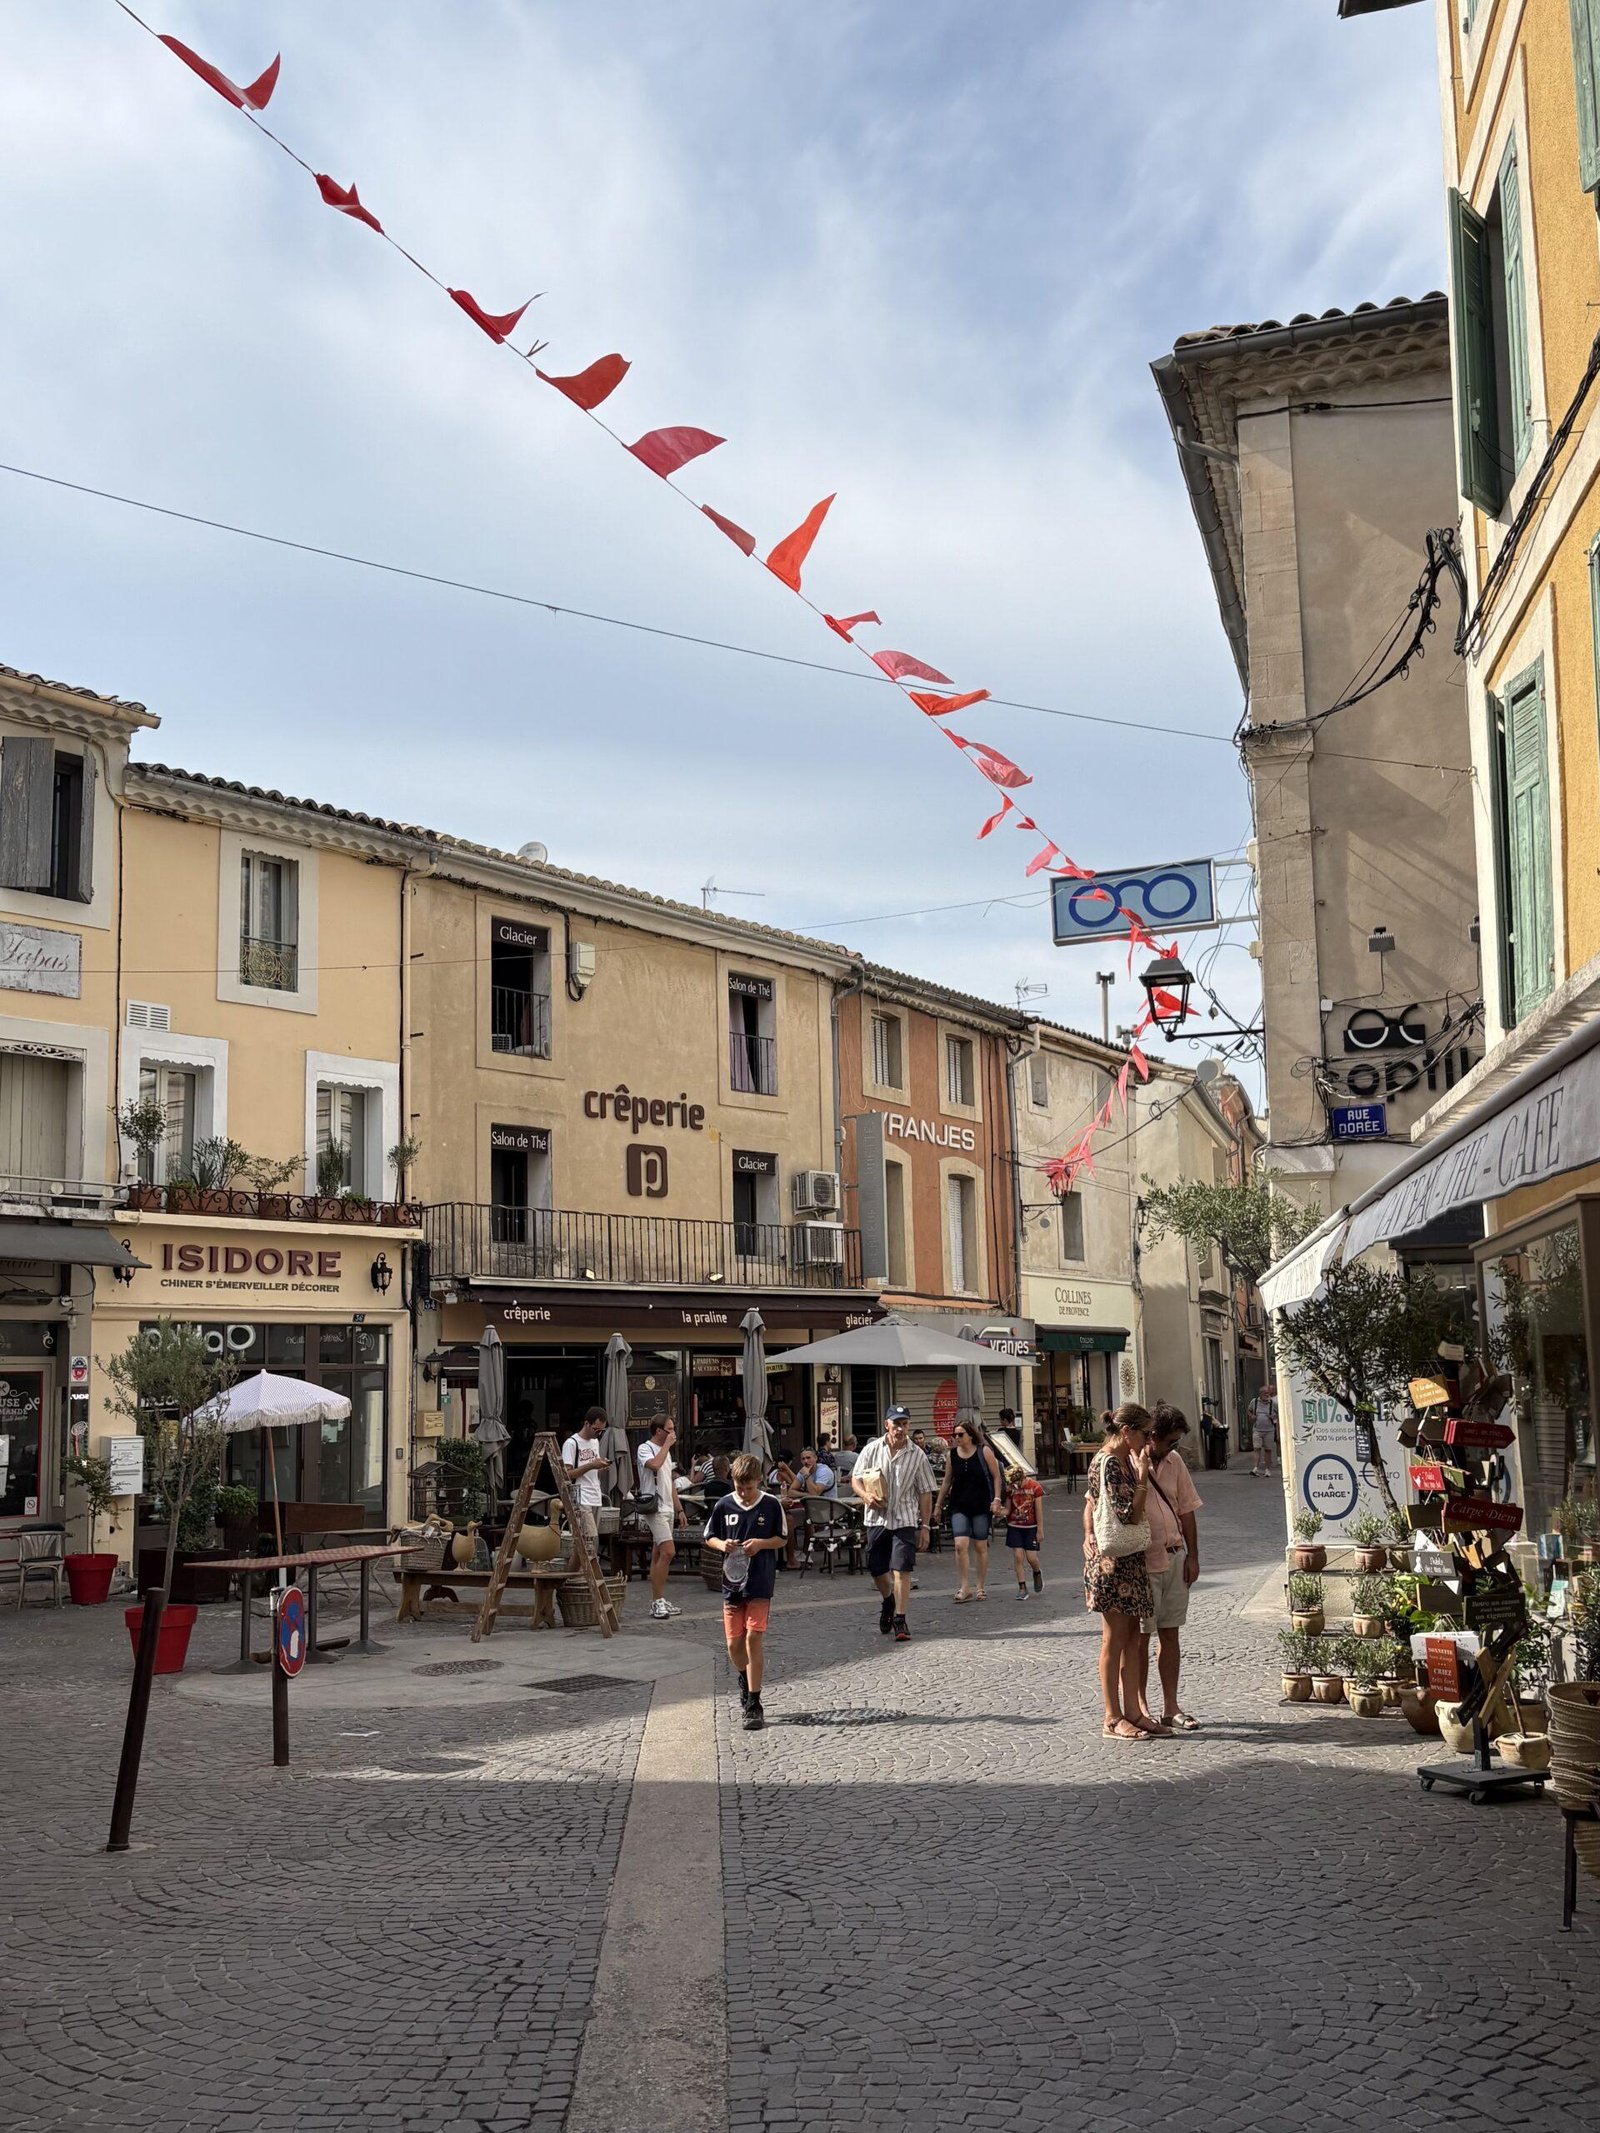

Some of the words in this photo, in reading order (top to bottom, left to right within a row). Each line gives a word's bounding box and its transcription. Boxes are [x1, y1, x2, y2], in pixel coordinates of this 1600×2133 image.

[500, 926, 538, 945] Glacier
[1, 929, 70, 976] Tapas
[728, 977, 747, 992] Salon
[747, 981, 757, 994] de
[758, 984, 771, 997] Thé
[584, 1084, 705, 1134] crêperie
[1347, 1108, 1370, 1121] RUE
[1339, 1120, 1381, 1134] DORÉE
[491, 1131, 515, 1147] Salon
[517, 1133, 529, 1148] de
[531, 1135, 547, 1150] Thé
[738, 1156, 768, 1171] Glacier
[161, 1243, 342, 1278] ISIDORE
[160, 1278, 203, 1289] CHINER
[205, 1278, 289, 1292] S'ÉMERVEILLER
[291, 1281, 340, 1293] DÉCORER
[1055, 1286, 1092, 1305] COLLINES
[503, 1306, 551, 1324] crêperie
[682, 1311, 692, 1324] la
[694, 1312, 728, 1327] praline
[846, 1314, 874, 1328] glacier
[1066, 1306, 1090, 1317] PROVENCE
[990, 1339, 1030, 1357] vranjes
[1335, 1434, 1347, 1443] pris
[1316, 1473, 1344, 1481] RESTE
[724, 1513, 739, 1526] 10
[1450, 1502, 1484, 1520] Carpe
[1487, 1508, 1517, 1524] Diem
[1433, 1668, 1452, 1677] CRIEZ
